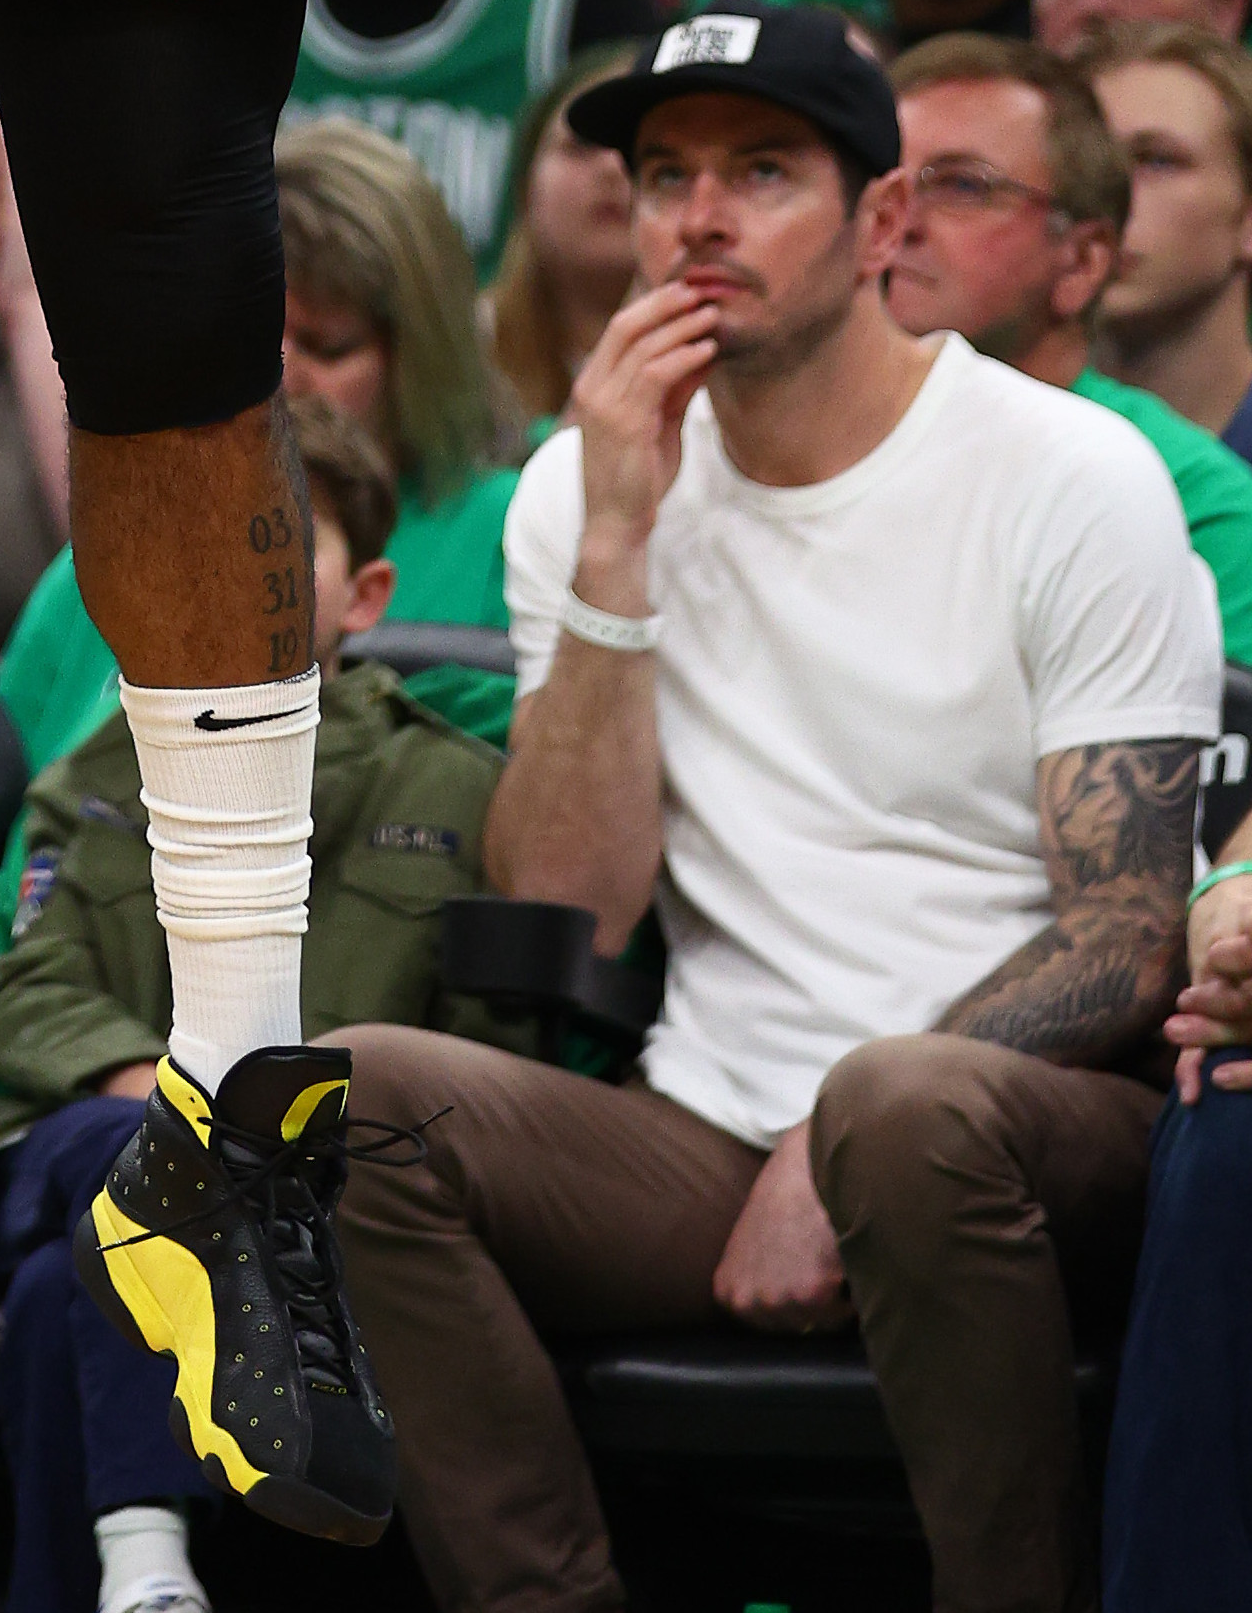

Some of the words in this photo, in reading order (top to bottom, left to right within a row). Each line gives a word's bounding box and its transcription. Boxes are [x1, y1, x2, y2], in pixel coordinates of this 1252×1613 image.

[249, 508, 292, 554] 03
[262, 566, 297, 615] 31
[267, 626, 298, 672] 19
